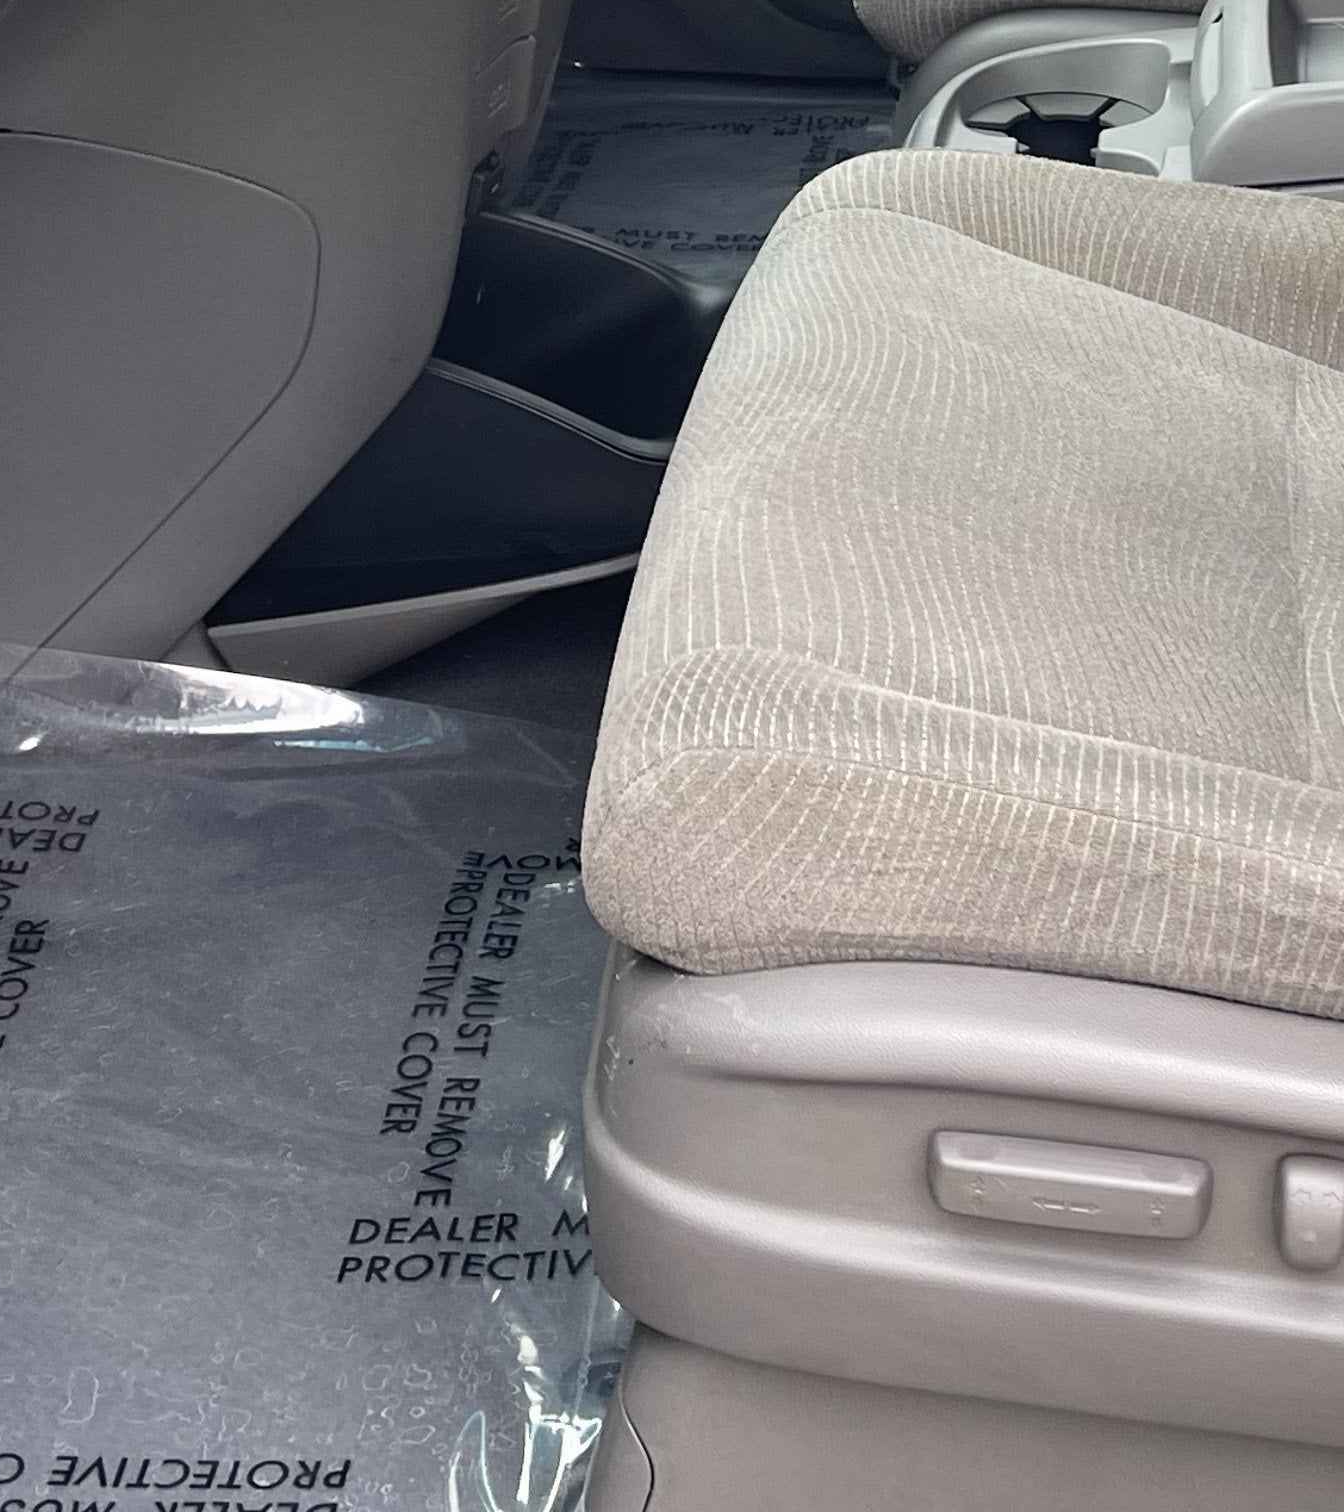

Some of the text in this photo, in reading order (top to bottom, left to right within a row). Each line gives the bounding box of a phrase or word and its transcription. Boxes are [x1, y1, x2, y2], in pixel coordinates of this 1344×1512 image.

[379, 867, 488, 1138] PROTECTIVE COVER
[414, 872, 531, 1208] DEALER MUST REMOVE
[349, 1213, 519, 1246] DEALER
[337, 1249, 594, 1285] PROTECTIV
[47, 1455, 352, 1489] PROTECTIVE
